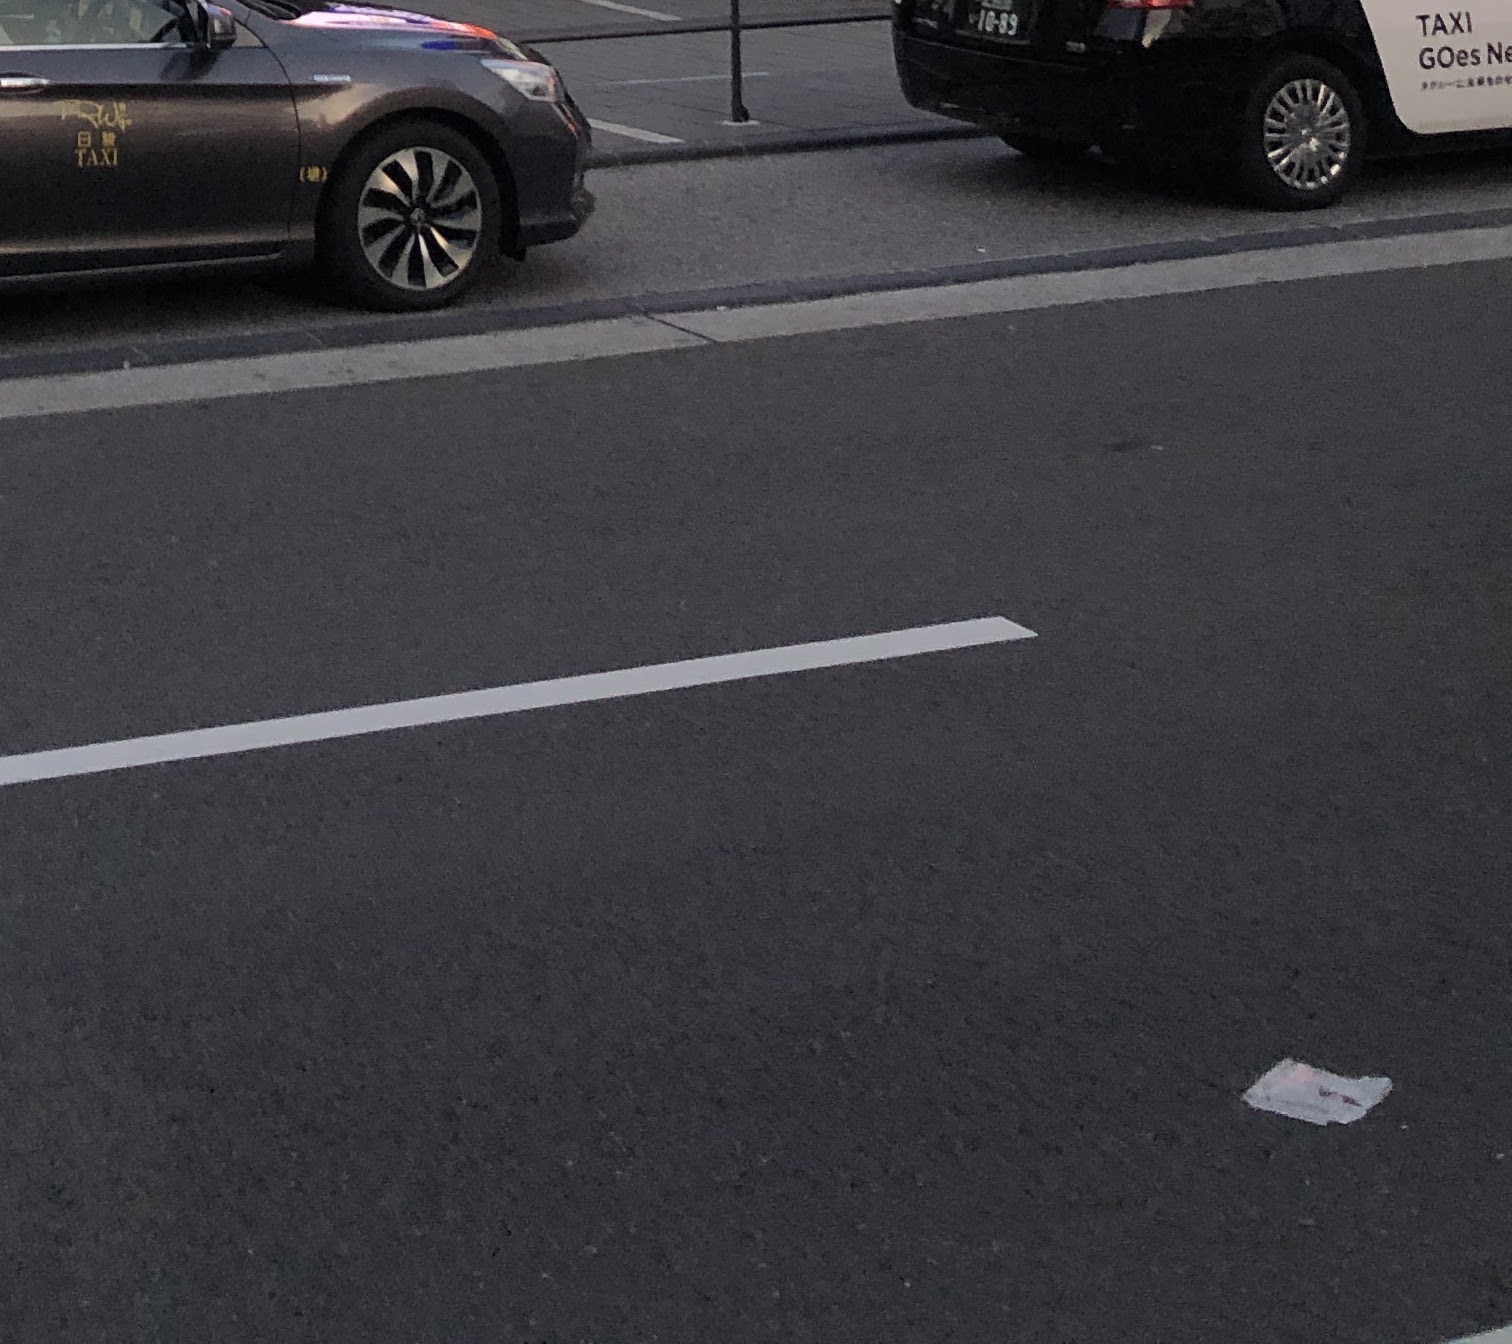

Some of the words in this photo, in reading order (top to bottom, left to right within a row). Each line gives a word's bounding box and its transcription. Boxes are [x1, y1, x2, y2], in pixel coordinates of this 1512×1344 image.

[1415, 10, 1472, 38] TAXI
[1418, 44, 1481, 70] GOes
[75, 148, 118, 167] TAXI
